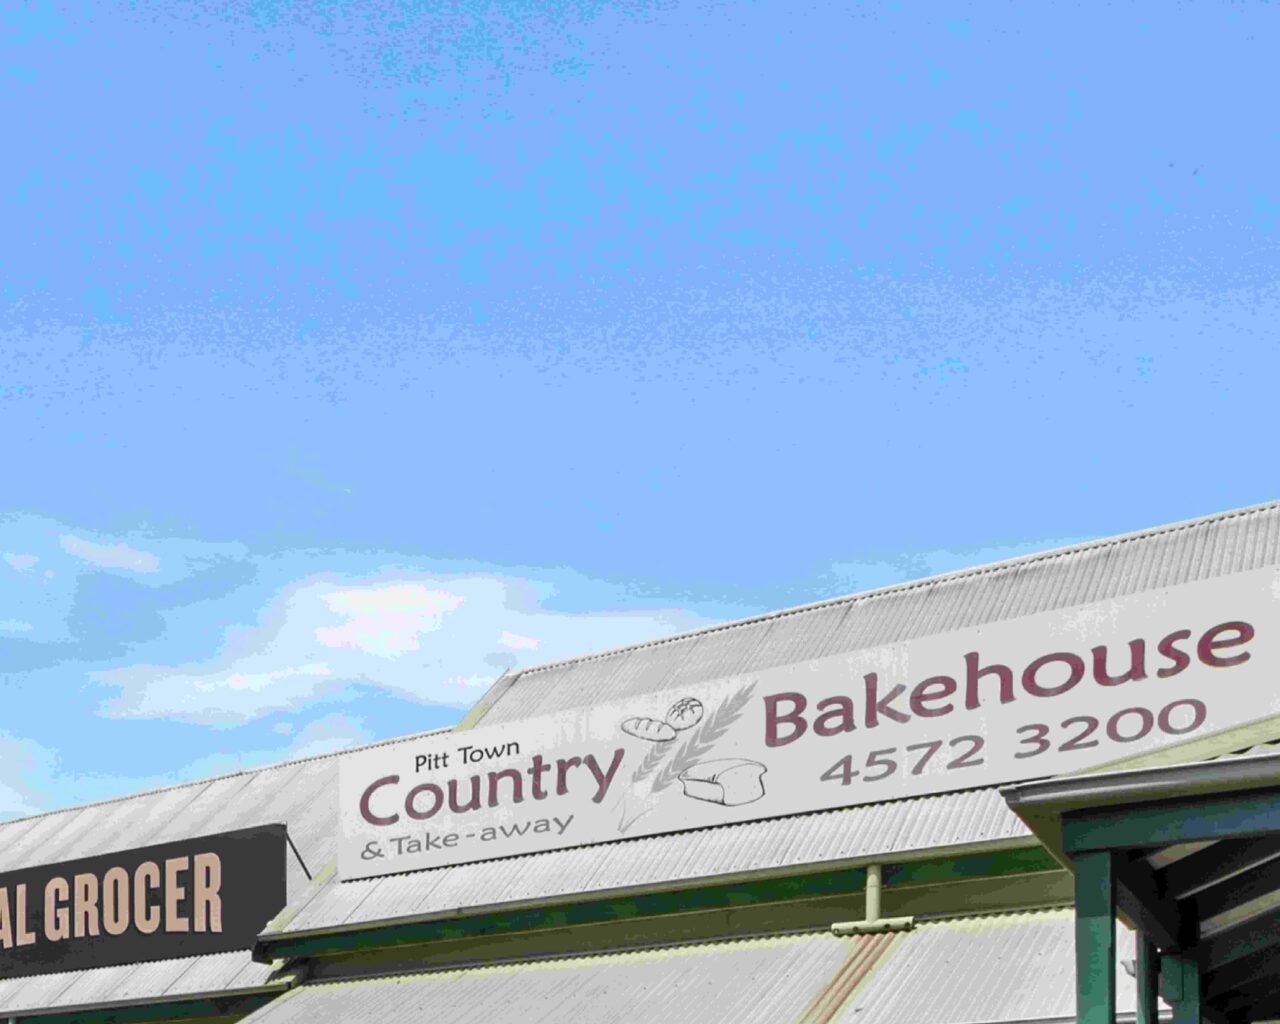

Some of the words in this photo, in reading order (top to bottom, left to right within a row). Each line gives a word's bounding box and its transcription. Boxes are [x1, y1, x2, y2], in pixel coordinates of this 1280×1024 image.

[762, 620, 1255, 748] Bakehouse
[415, 752, 450, 773] Pitt
[457, 741, 520, 765] Town
[819, 734, 985, 786] 4572
[1013, 698, 1208, 759] 3200
[359, 748, 625, 827] Country
[360, 840, 385, 861] &
[390, 814, 574, 856] Take-away
[44, 851, 223, 942] GROCER
